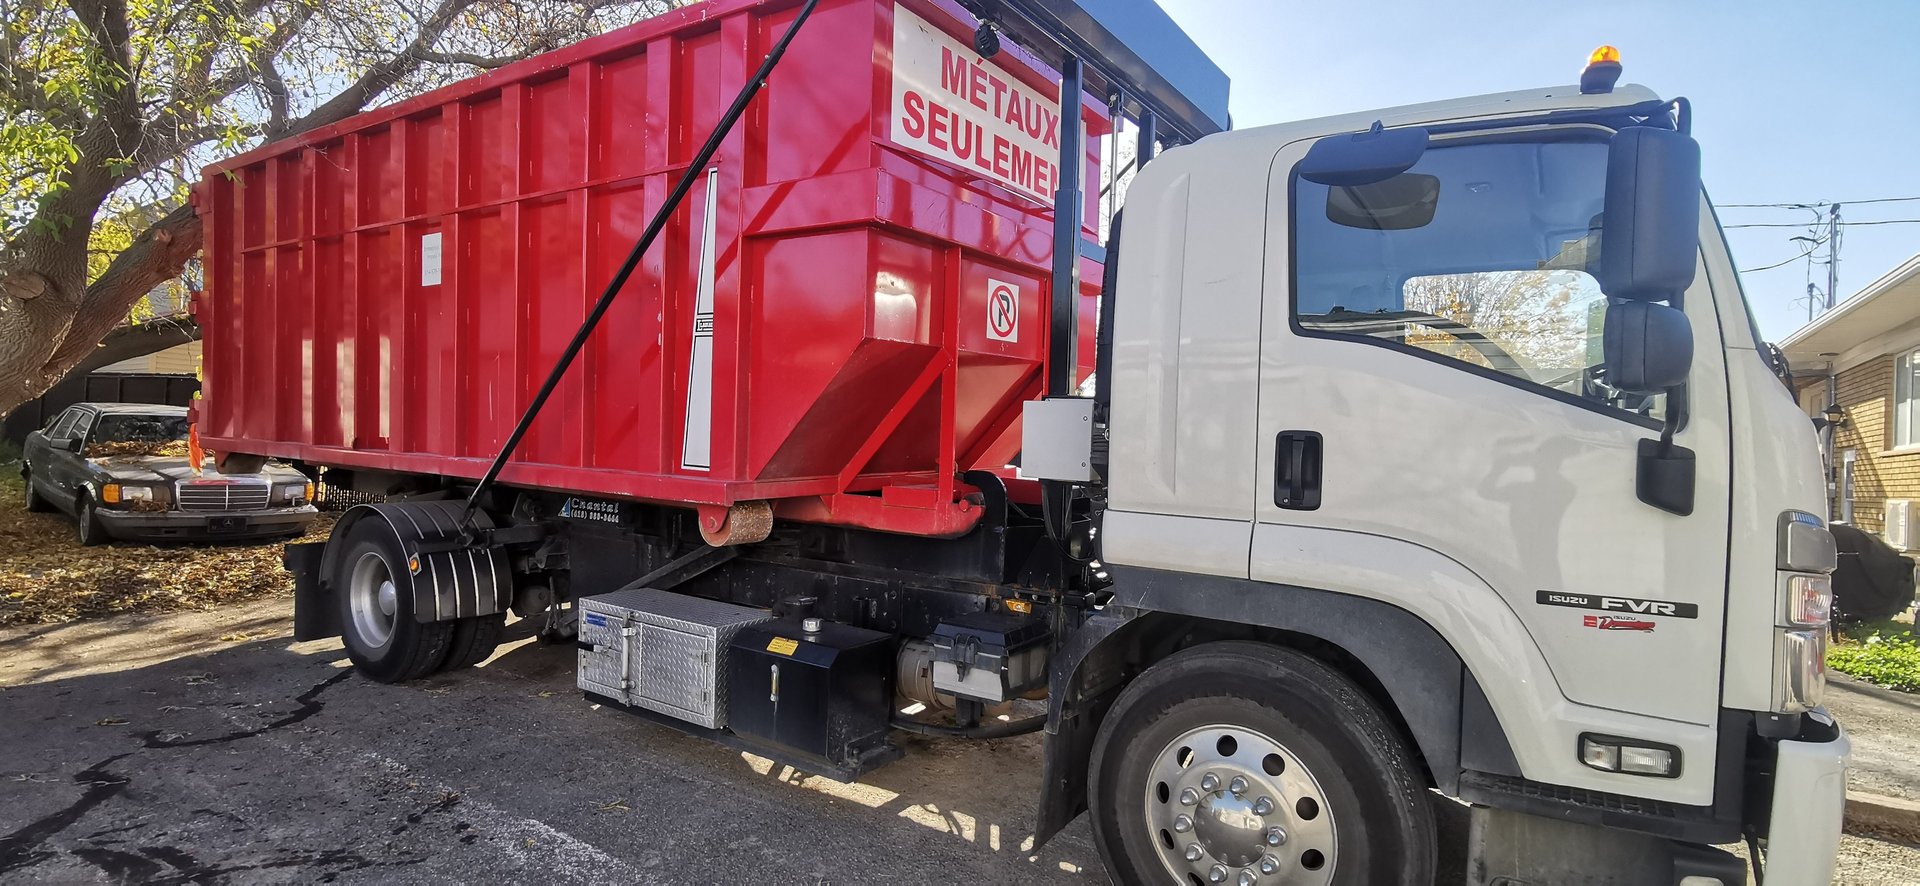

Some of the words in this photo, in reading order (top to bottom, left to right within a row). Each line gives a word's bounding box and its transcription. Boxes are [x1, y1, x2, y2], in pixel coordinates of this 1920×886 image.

[942, 46, 1058, 150] MÉTAUX
[902, 90, 1058, 200] SEULEMEN
[571, 497, 619, 514] Chantal
[1549, 594, 1588, 605] ISUZU
[1601, 597, 1676, 616] FVR
